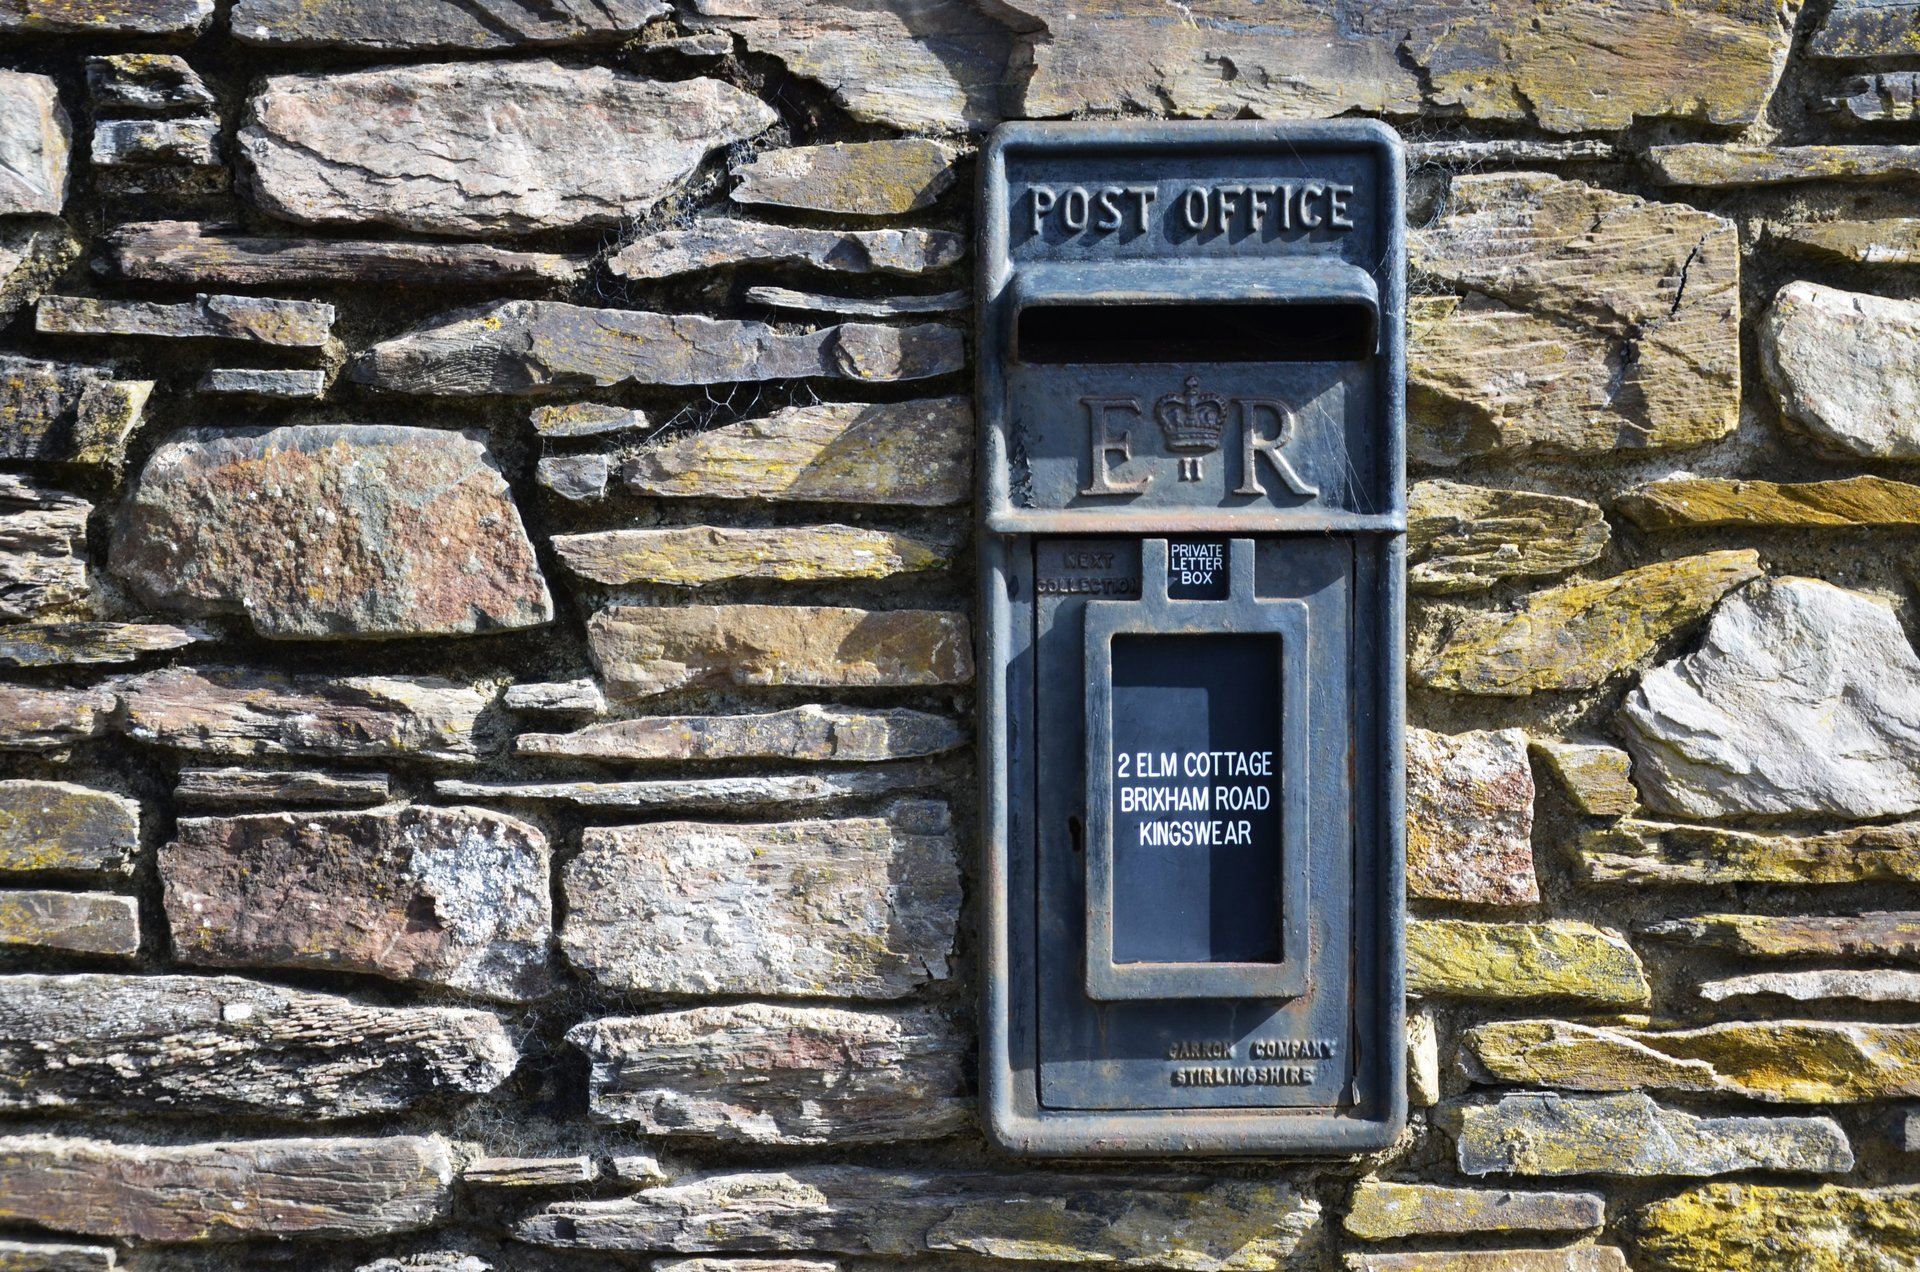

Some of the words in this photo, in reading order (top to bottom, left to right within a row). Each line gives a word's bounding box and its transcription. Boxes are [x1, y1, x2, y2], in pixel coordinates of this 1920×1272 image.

[1027, 184, 1158, 234] POST
[1182, 184, 1354, 233] OFFICE
[1080, 396, 1153, 497] E
[1231, 399, 1319, 497] R
[1063, 552, 1114, 569] NEXT
[1171, 544, 1223, 557] PRIVATE
[1171, 558, 1223, 571] LETTER
[1181, 571, 1213, 585] BOX
[1117, 752, 1131, 778] 2
[1136, 752, 1177, 777] ELM
[1183, 751, 1273, 777] COTTAGE
[1121, 786, 1209, 812] BRIXHAM
[1215, 786, 1271, 811] ROAD
[1139, 820, 1252, 846] KINGSWEAR
[1167, 1040, 1236, 1060] CARRON
[1252, 1038, 1338, 1059] COMPANY
[1174, 1066, 1317, 1085] STIRLINGSHIRE
